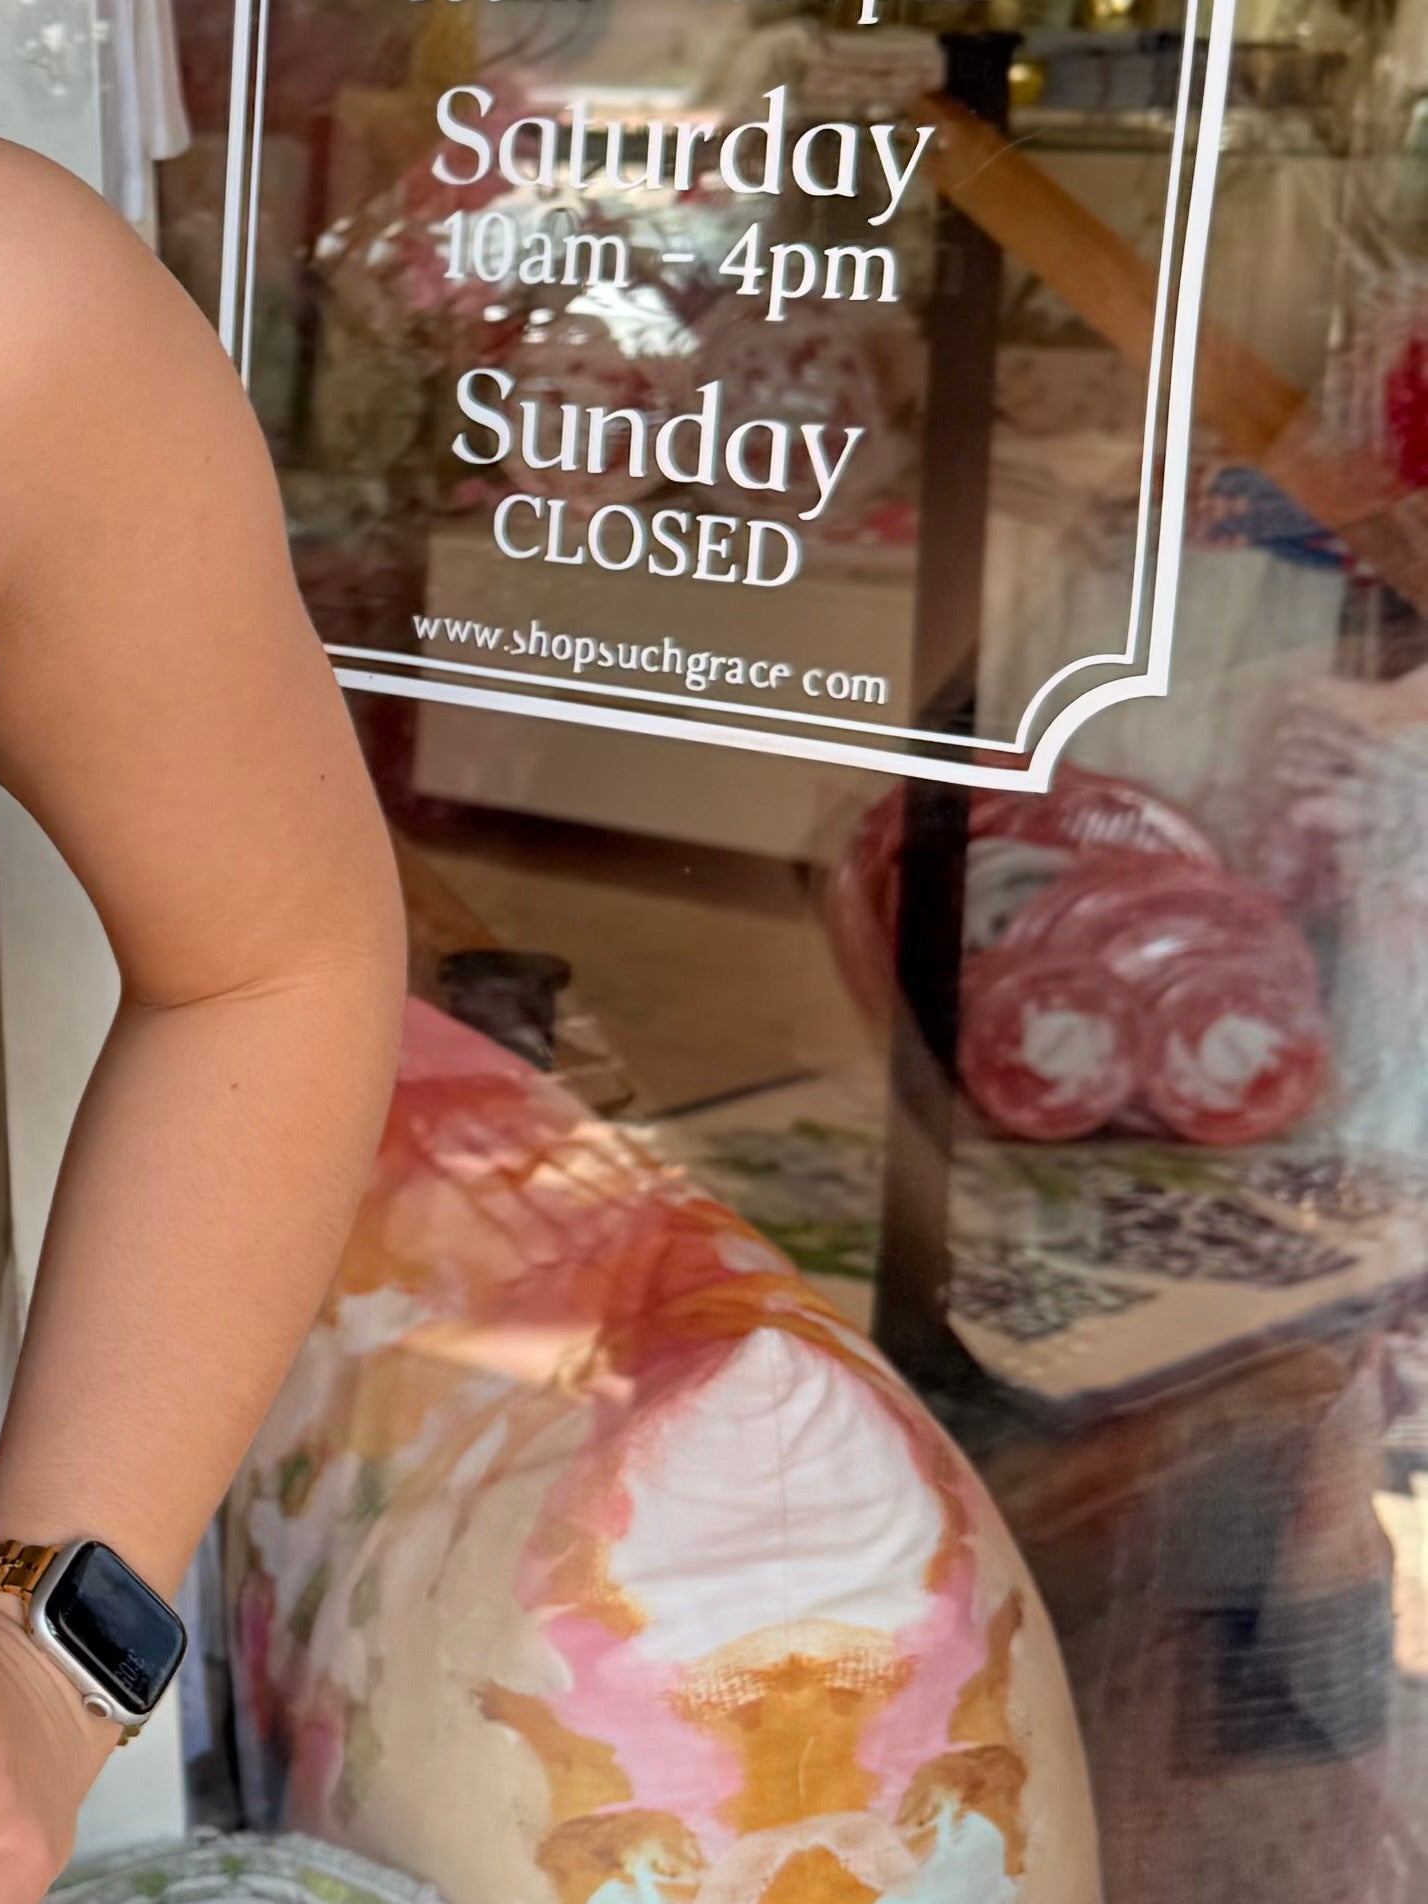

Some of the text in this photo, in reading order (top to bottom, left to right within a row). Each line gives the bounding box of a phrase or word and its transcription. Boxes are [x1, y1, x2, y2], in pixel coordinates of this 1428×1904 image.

[431, 84, 935, 227] Saturday
[441, 209, 630, 288] 10am
[717, 222, 899, 322] 4pm
[451, 367, 865, 521] Sunday
[493, 494, 804, 589] CLOSED
[412, 614, 887, 705] www.shopsuchgracecom
